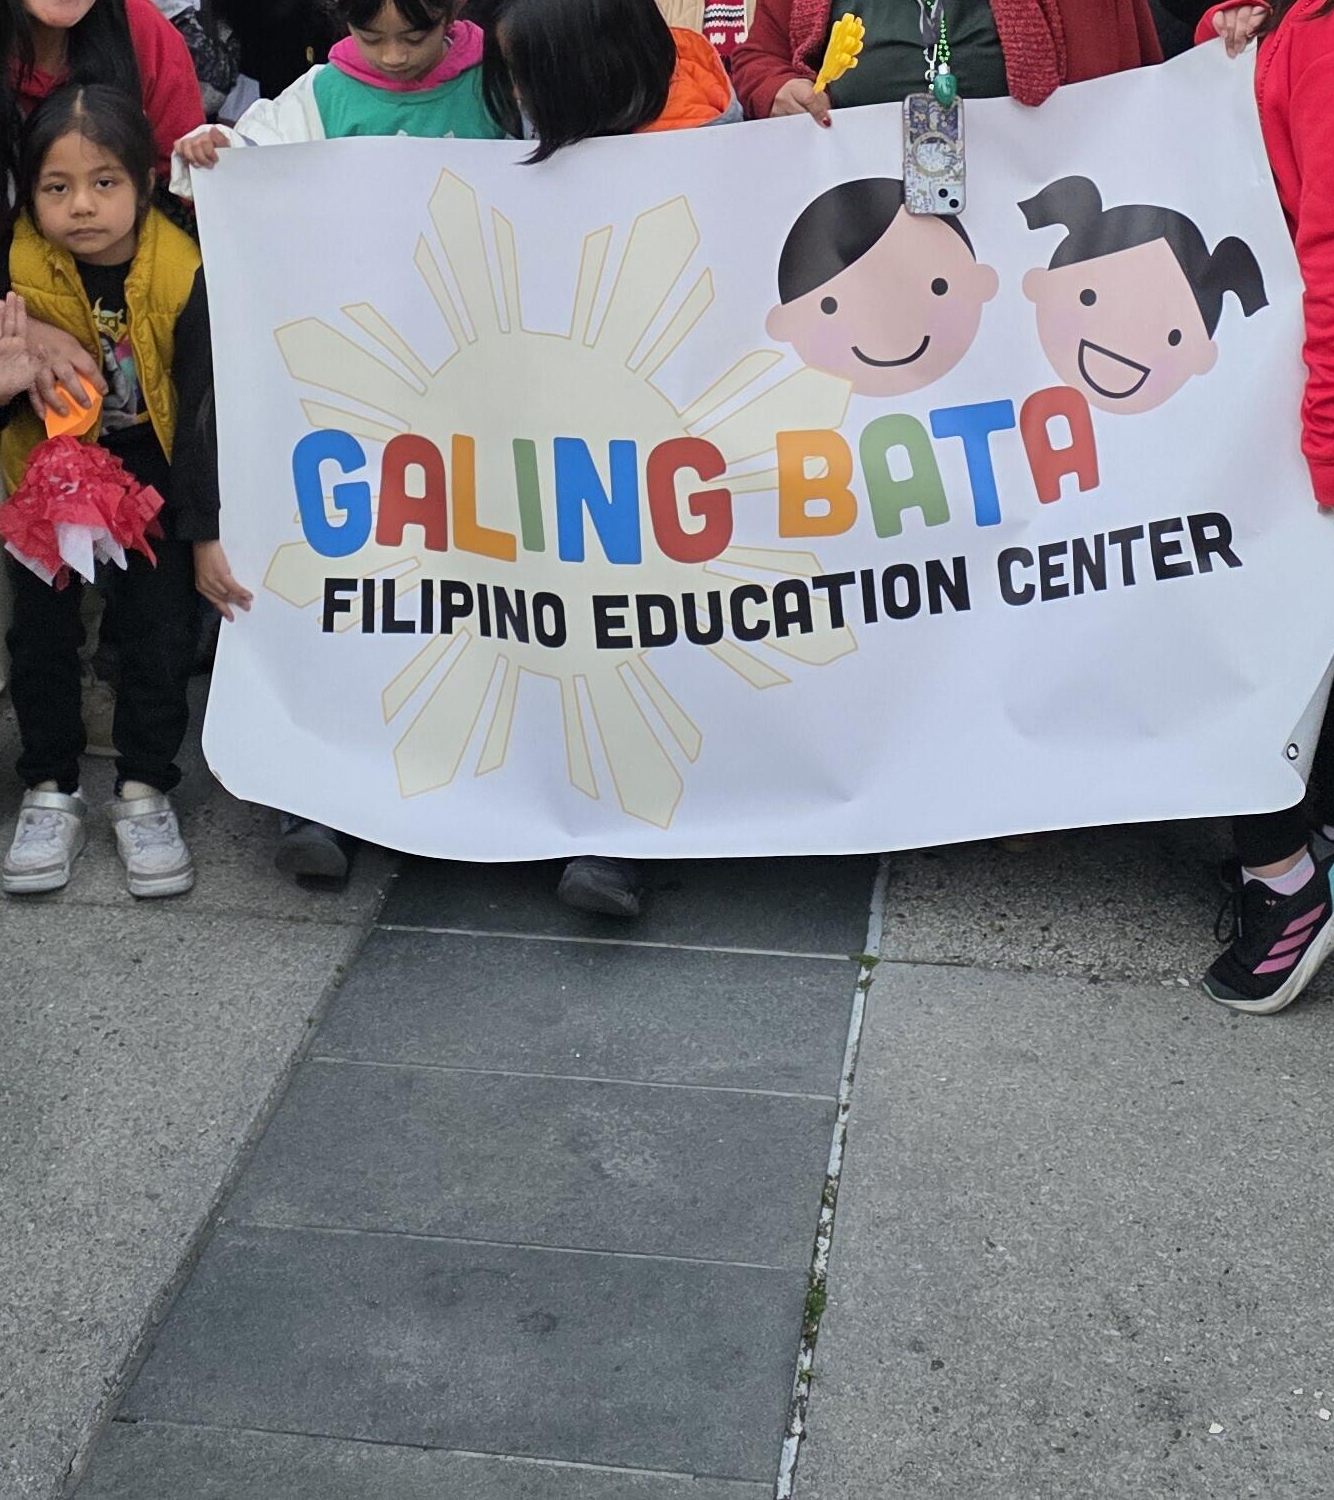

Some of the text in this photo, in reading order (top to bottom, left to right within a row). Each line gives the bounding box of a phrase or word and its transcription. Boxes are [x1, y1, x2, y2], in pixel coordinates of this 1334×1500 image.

[292, 385, 1100, 564] GALING BATA
[322, 511, 1243, 649] FILIPINO EDUCATION CENTER
